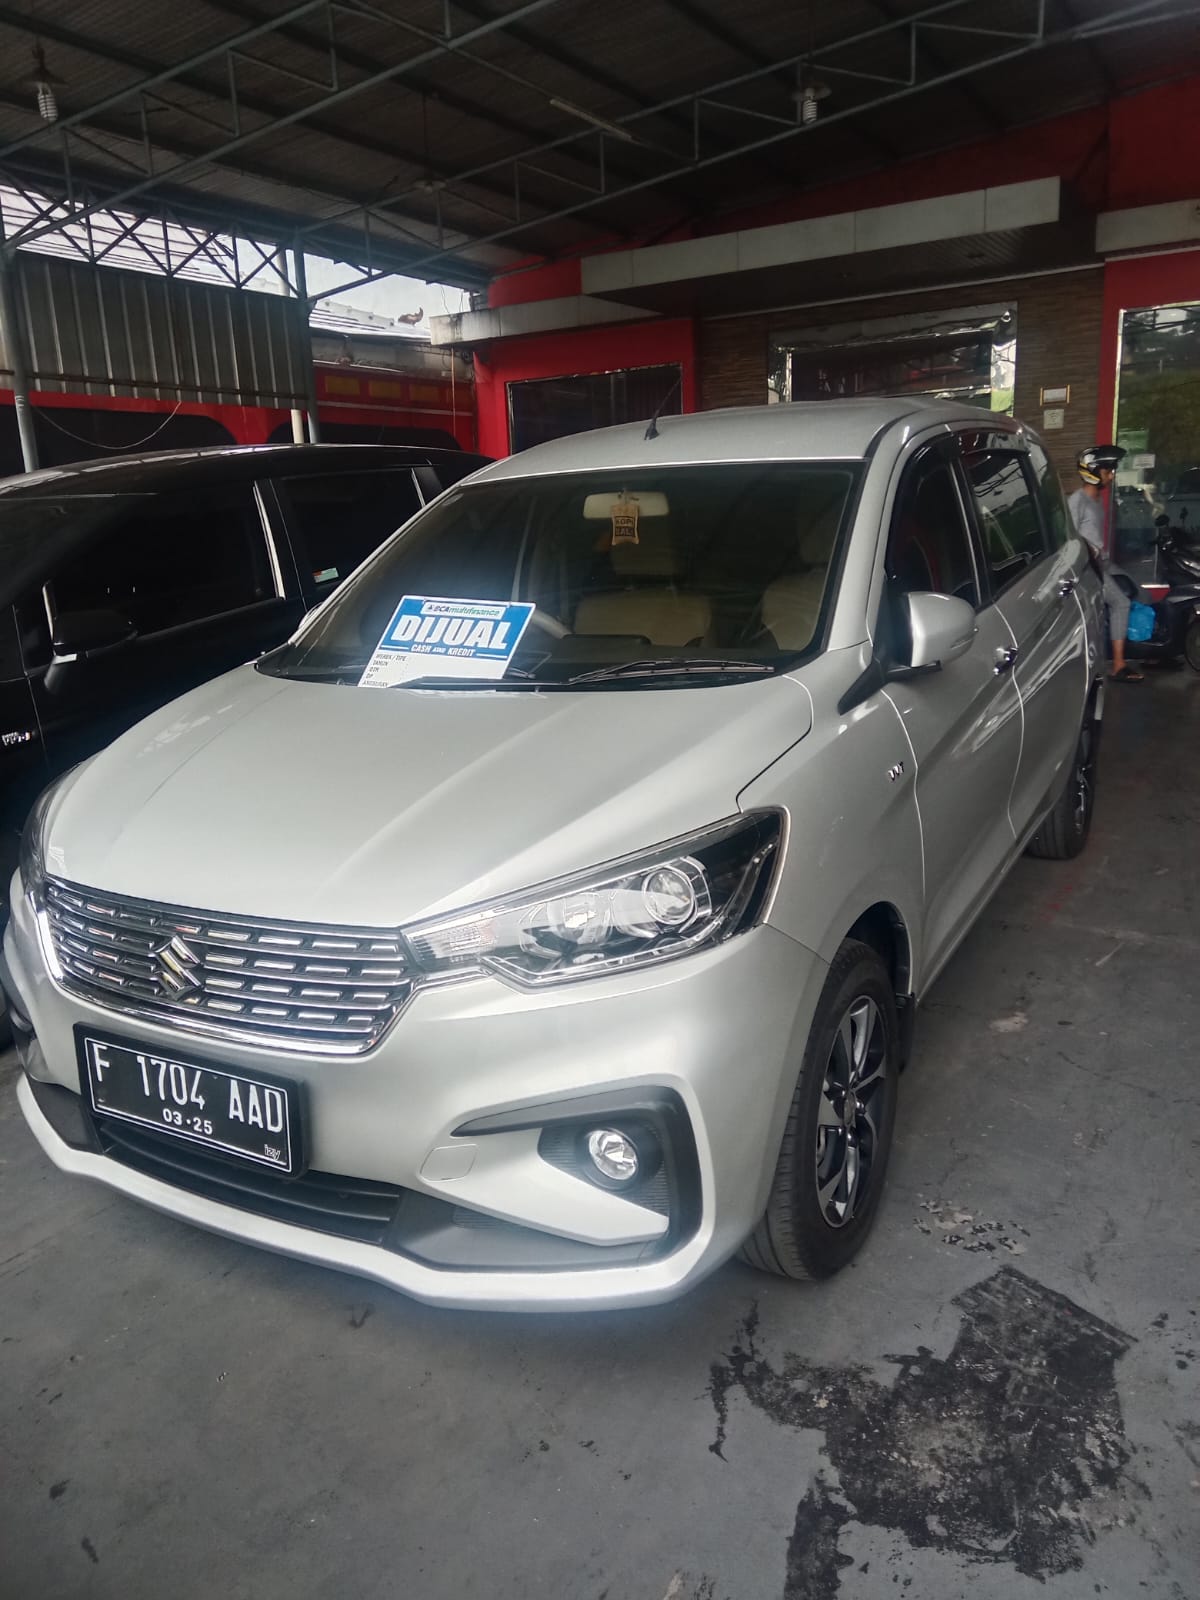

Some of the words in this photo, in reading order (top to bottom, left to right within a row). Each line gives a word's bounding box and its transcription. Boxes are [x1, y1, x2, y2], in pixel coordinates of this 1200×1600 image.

[390, 614, 512, 650] DIJUAL
[410, 643, 433, 654] CASH
[447, 647, 476, 657] KREDIT
[92, 1042, 111, 1082] F
[136, 1054, 206, 1111] 1704
[228, 1078, 283, 1133] AAD
